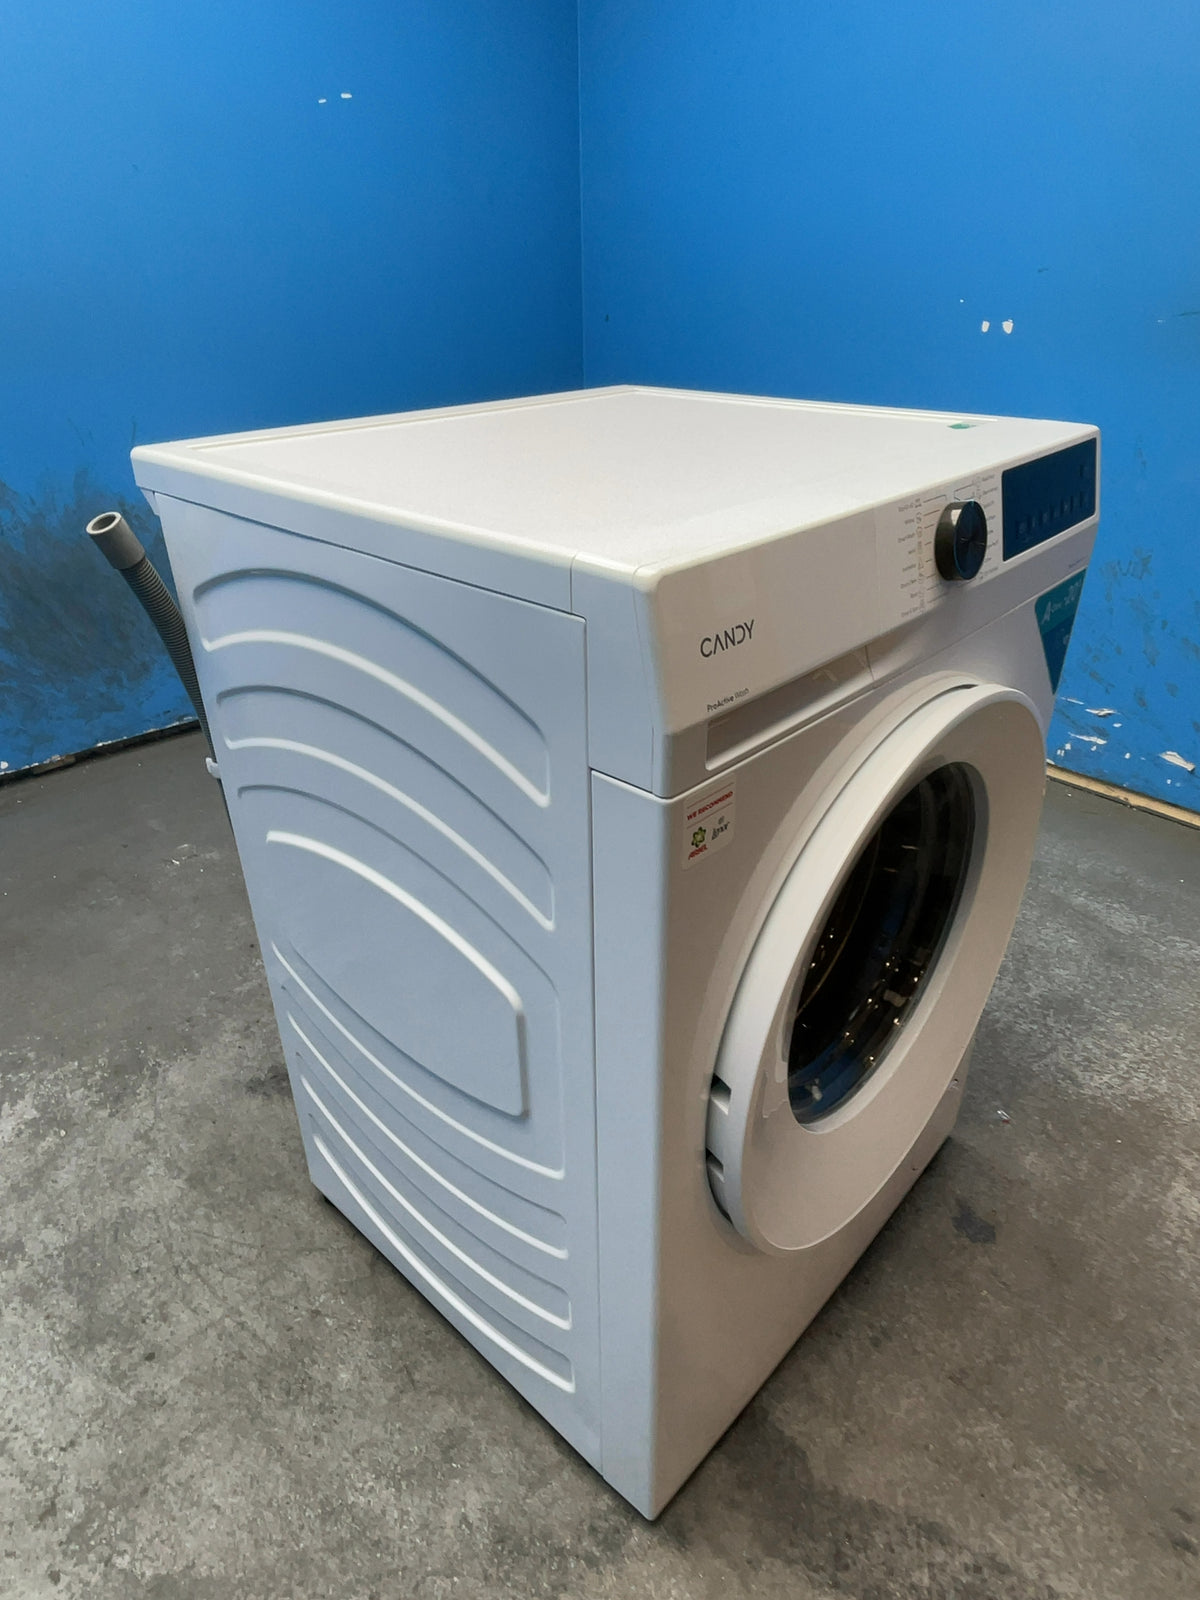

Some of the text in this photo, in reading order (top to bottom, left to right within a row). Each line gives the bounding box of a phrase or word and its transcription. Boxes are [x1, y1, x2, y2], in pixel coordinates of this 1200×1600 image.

[700, 619, 754, 658] CANDY
[706, 695, 735, 713] ProActive
[687, 790, 734, 820] WE RECOMMEND
